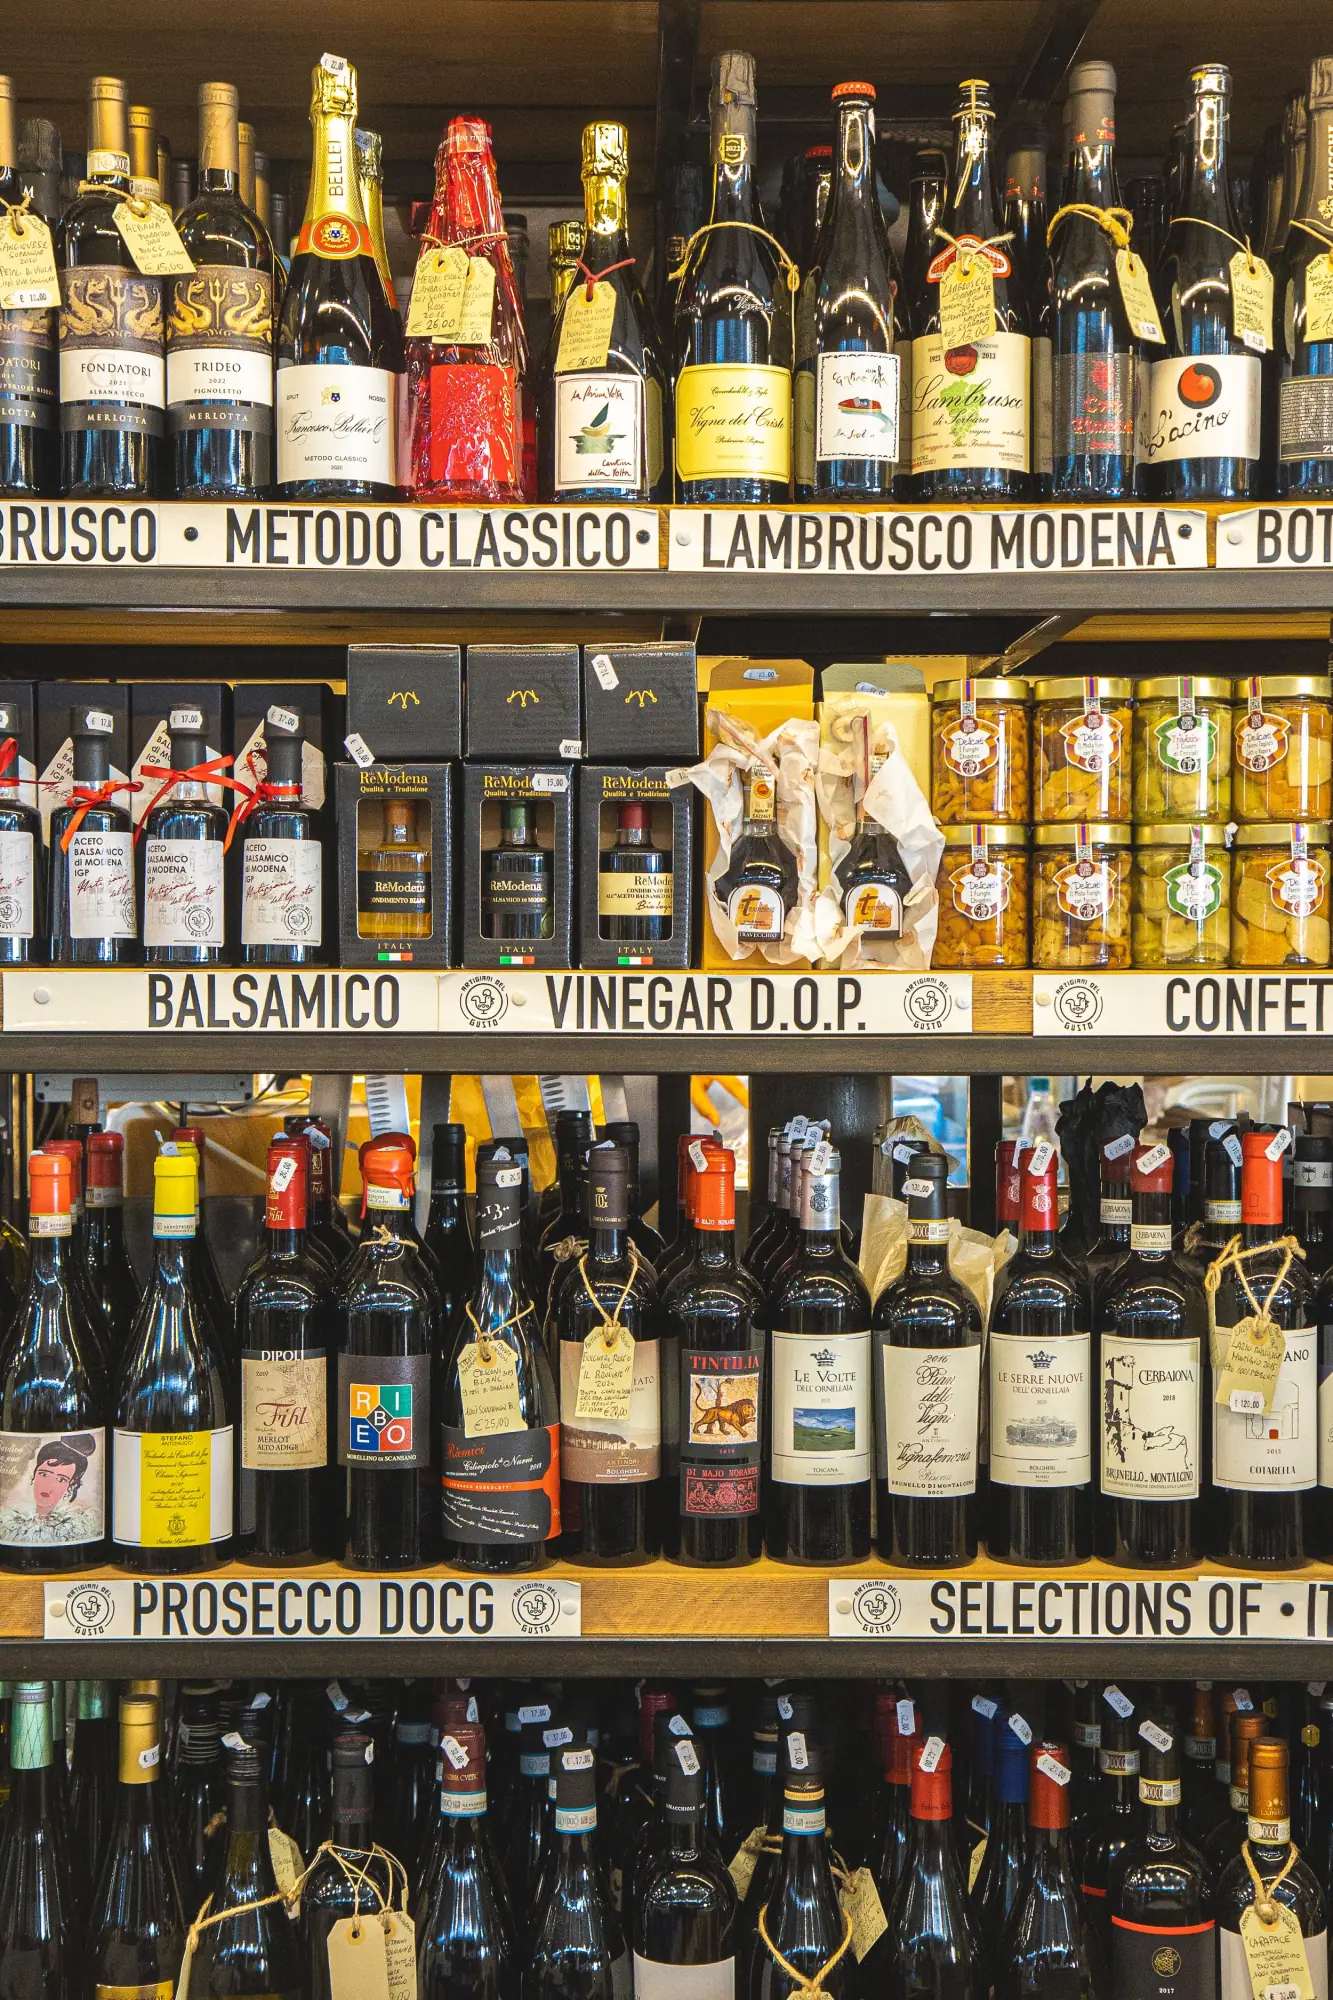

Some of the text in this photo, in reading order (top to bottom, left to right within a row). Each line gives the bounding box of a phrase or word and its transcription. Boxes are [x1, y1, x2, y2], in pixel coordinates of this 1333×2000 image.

[329, 140, 343, 197] BELLEI
[81, 362, 151, 377] FONDATORI
[194, 362, 242, 372] TRIDEO
[912, 374, 1024, 415] Lambrusco
[87, 413, 147, 425] MERLOTTA
[189, 412, 248, 422] MERLOTTA
[690, 406, 725, 436] Vigna
[728, 414, 749, 427] del
[933, 409, 989, 427] di Sorbara
[284, 409, 329, 445] Francesco
[335, 455, 367, 463] CLASSICO
[226, 508, 631, 568] METODO CLASSICO
[703, 510, 1176, 571] LAMBRUSCO MODENA
[279, 713, 295, 727] 17.00
[546, 778, 564, 787] 15.00
[360, 785, 384, 793] Qualità
[400, 785, 428, 793] Tradizione
[484, 789, 552, 797] Qualità Tradizione
[602, 789, 627, 798] Qualità
[74, 837, 103, 846] ACETO
[147, 844, 167, 853] ACETO
[246, 843, 267, 852] ACETO
[74, 858, 82, 867] di
[147, 855, 188, 864] BALSAMICO
[246, 854, 289, 863] BALSAMICO
[74, 869, 90, 877] IGP
[152, 865, 186, 874] MODENA
[251, 865, 287, 873] MODENA
[246, 875, 254, 884] IGP
[378, 942, 413, 950] ITALY
[618, 946, 653, 954] ITALY
[149, 974, 400, 1028] BALSAMICO
[546, 976, 866, 1031] VINEGAR D.O.P.
[1166, 977, 1333, 1032] CONFET
[469, 1018, 498, 1028] GUSTO
[914, 1020, 942, 1030] GUSTO
[1064, 1022, 1093, 1031] GUSTO
[261, 1350, 304, 1361] DIPOLI
[923, 1354, 951, 1364] 2016
[690, 1355, 760, 1370] TINTILIA
[998, 1372, 1084, 1385] LE SERRE NUOVE
[1138, 1369, 1195, 1385] CERBAIONA
[385, 1454, 417, 1462] SCANSANO
[687, 1468, 696, 1476] DI
[702, 1469, 724, 1477] MAJO
[892, 1480, 926, 1488] BRUNELLO
[134, 1581, 494, 1636] PROSECCO DOCG
[930, 1581, 1262, 1636] SELECTIONS OF
[75, 1626, 104, 1636] GUSTO
[521, 1624, 550, 1634] GUSTO
[862, 1624, 891, 1633] GUSTO
